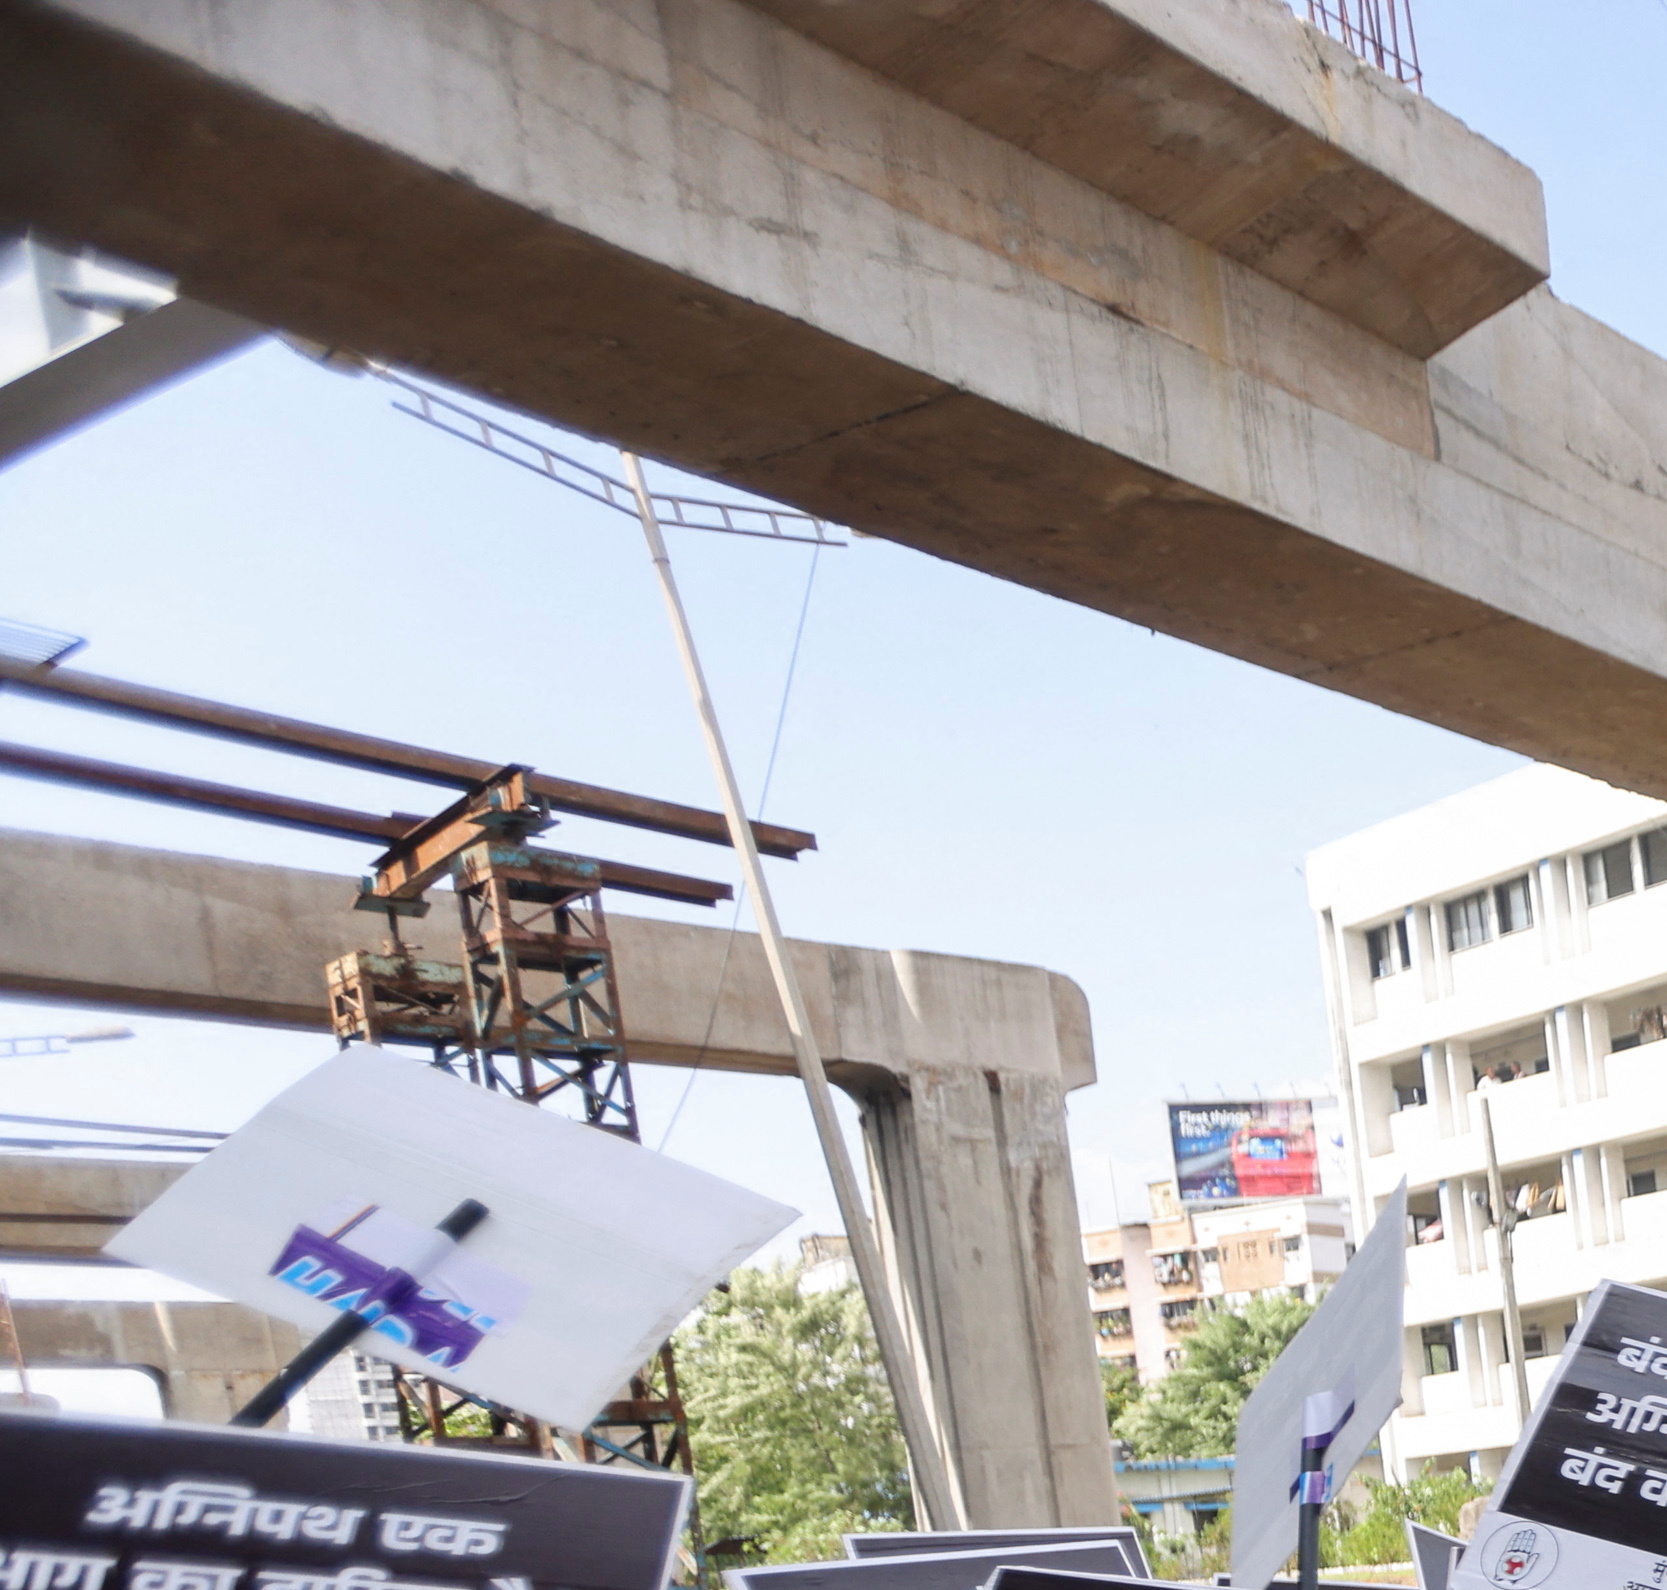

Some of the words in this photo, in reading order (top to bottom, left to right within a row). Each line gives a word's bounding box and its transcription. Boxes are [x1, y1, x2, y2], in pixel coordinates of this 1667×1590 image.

[1178, 1109, 1209, 1124] First
[1210, 1108, 1251, 1127] things
[1560, 1446, 1636, 1494] बंद
[84, 1481, 367, 1545] अग्निपथ
[378, 1511, 509, 1556] एक
